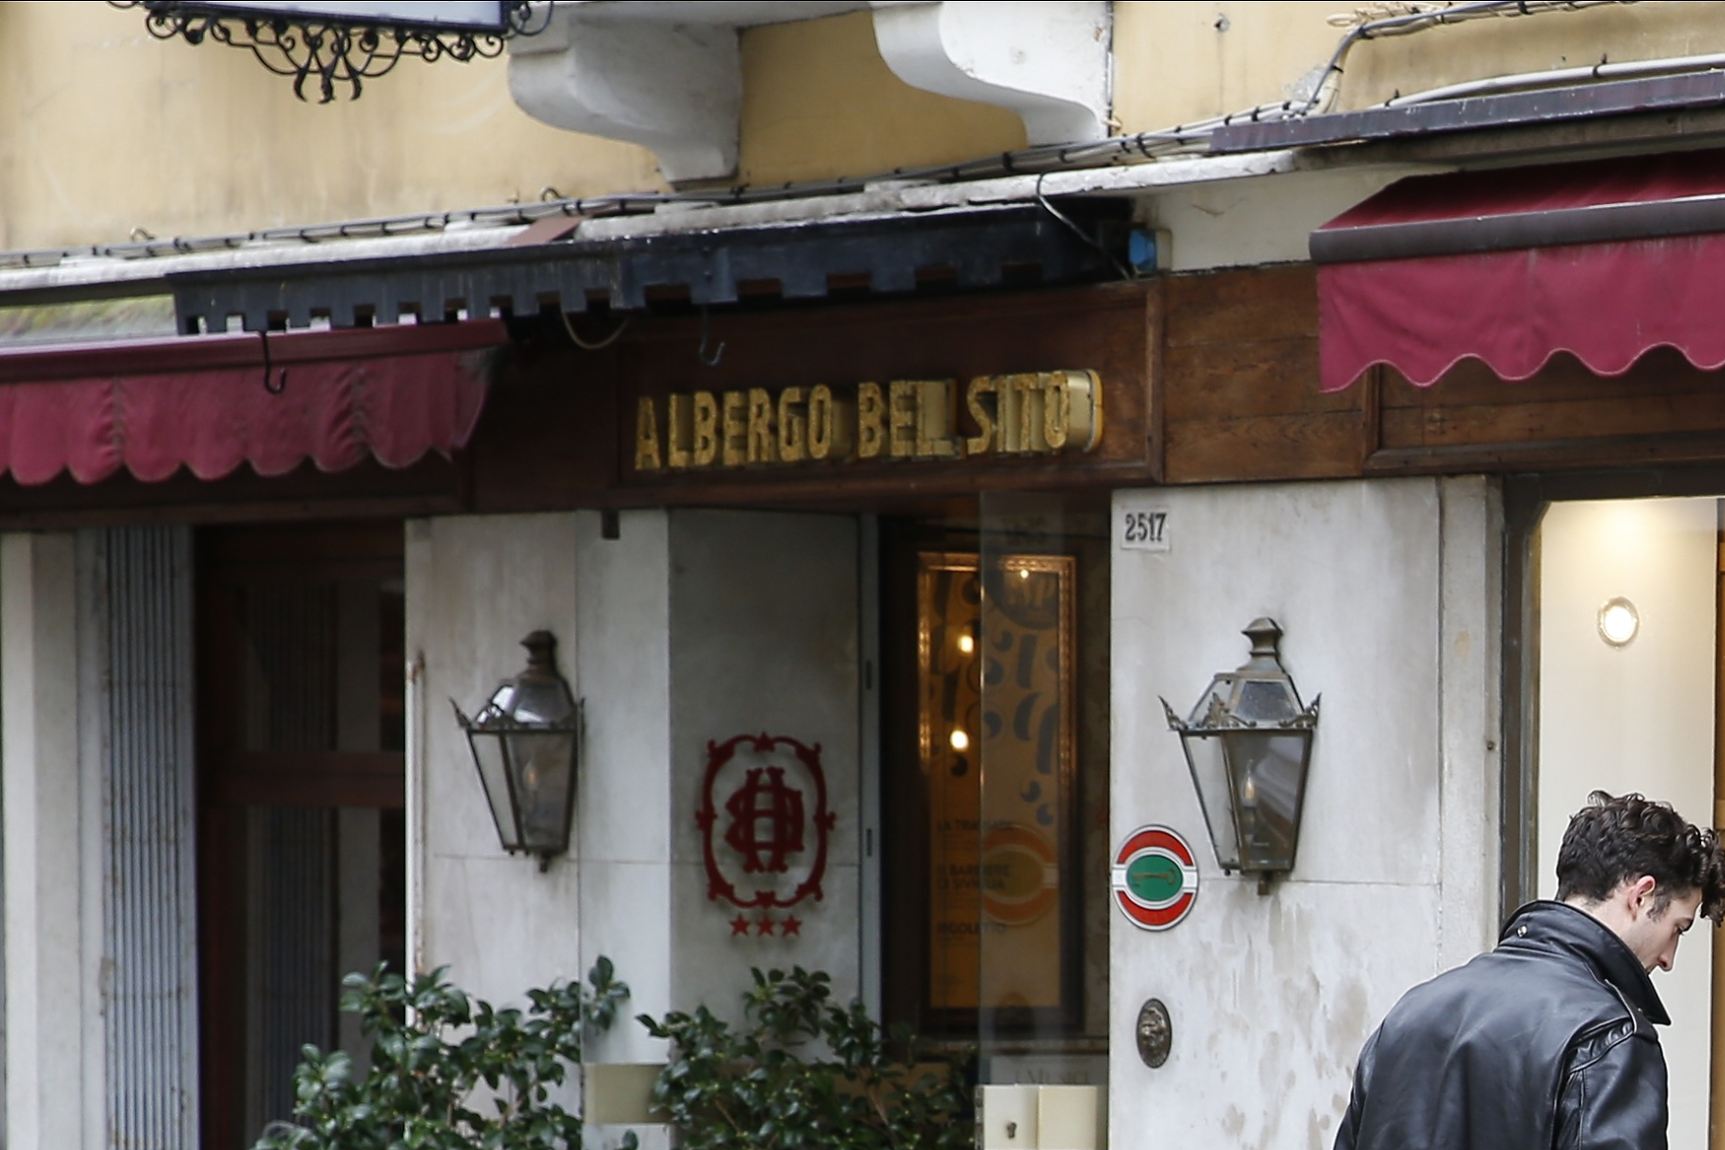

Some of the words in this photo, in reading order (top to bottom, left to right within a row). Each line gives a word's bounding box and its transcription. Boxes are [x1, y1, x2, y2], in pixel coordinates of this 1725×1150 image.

[635, 384, 840, 470] ALBERGO
[858, 378, 957, 458] BEL
[967, 370, 1102, 454] SITO
[1125, 512, 1167, 541] 2517
